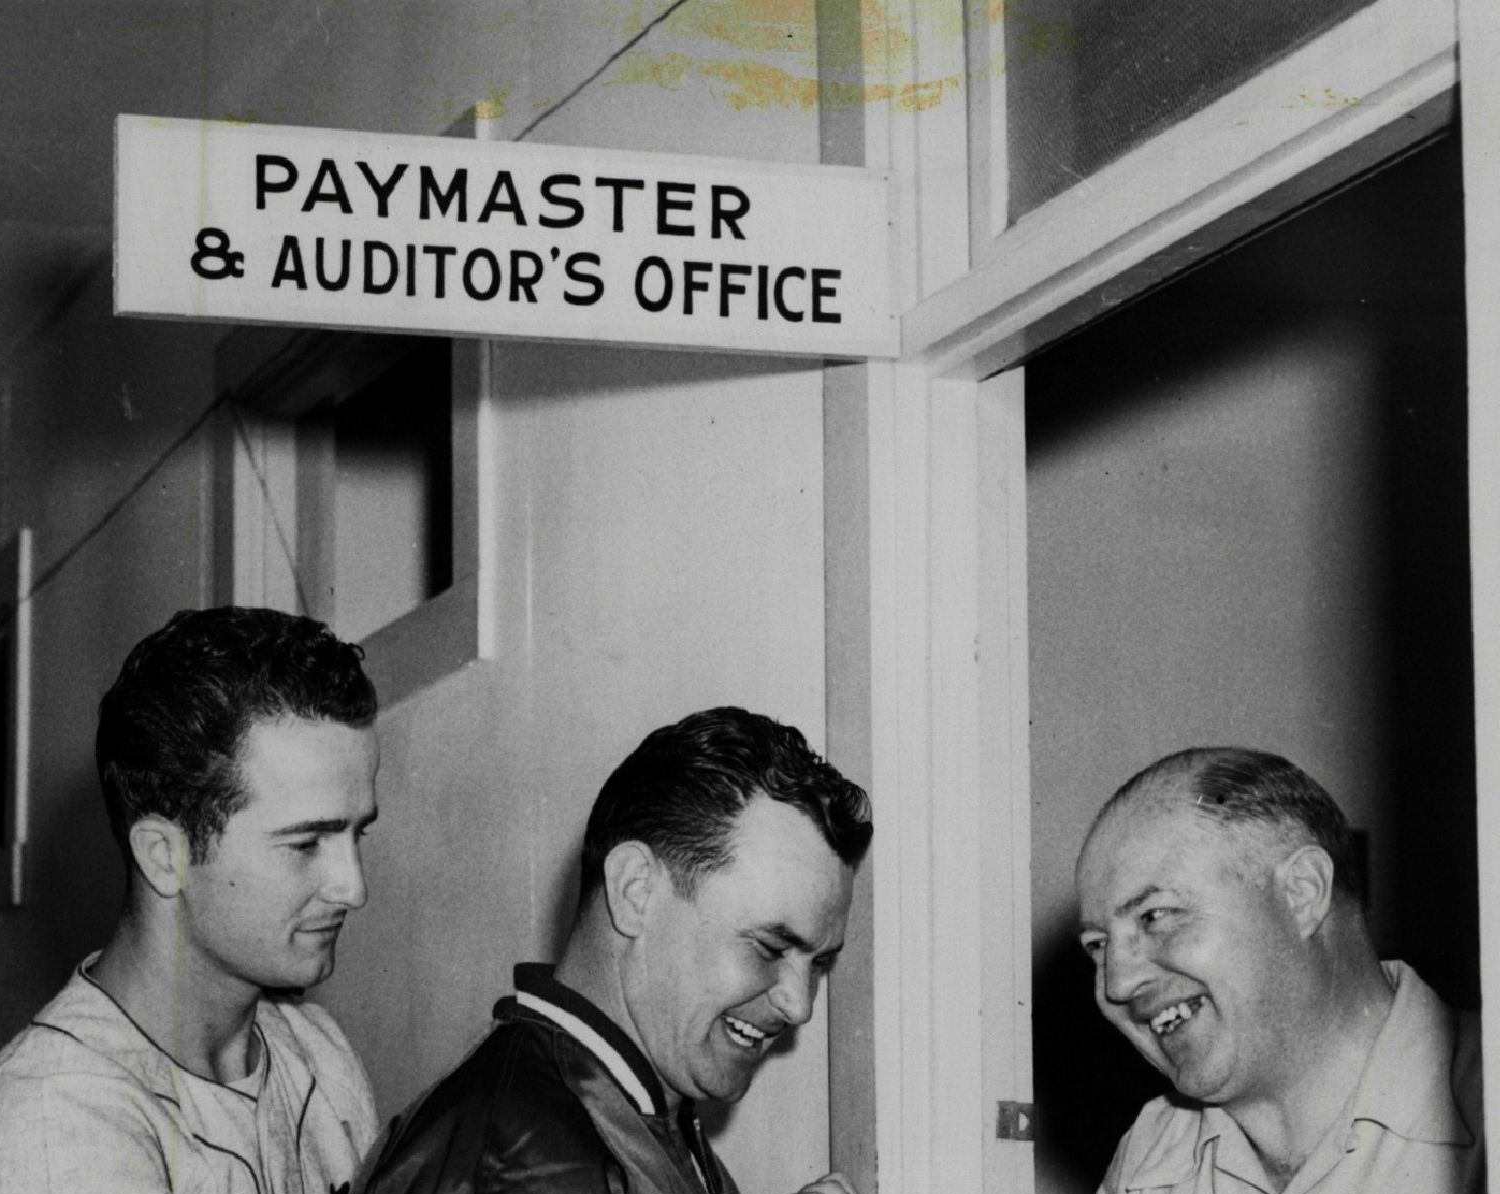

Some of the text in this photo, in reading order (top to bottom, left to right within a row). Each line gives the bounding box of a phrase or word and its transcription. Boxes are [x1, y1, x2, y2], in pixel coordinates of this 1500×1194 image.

[255, 154, 751, 240] PAYMASTER
[190, 227, 842, 324] & AUDITOR'S OFFICE
